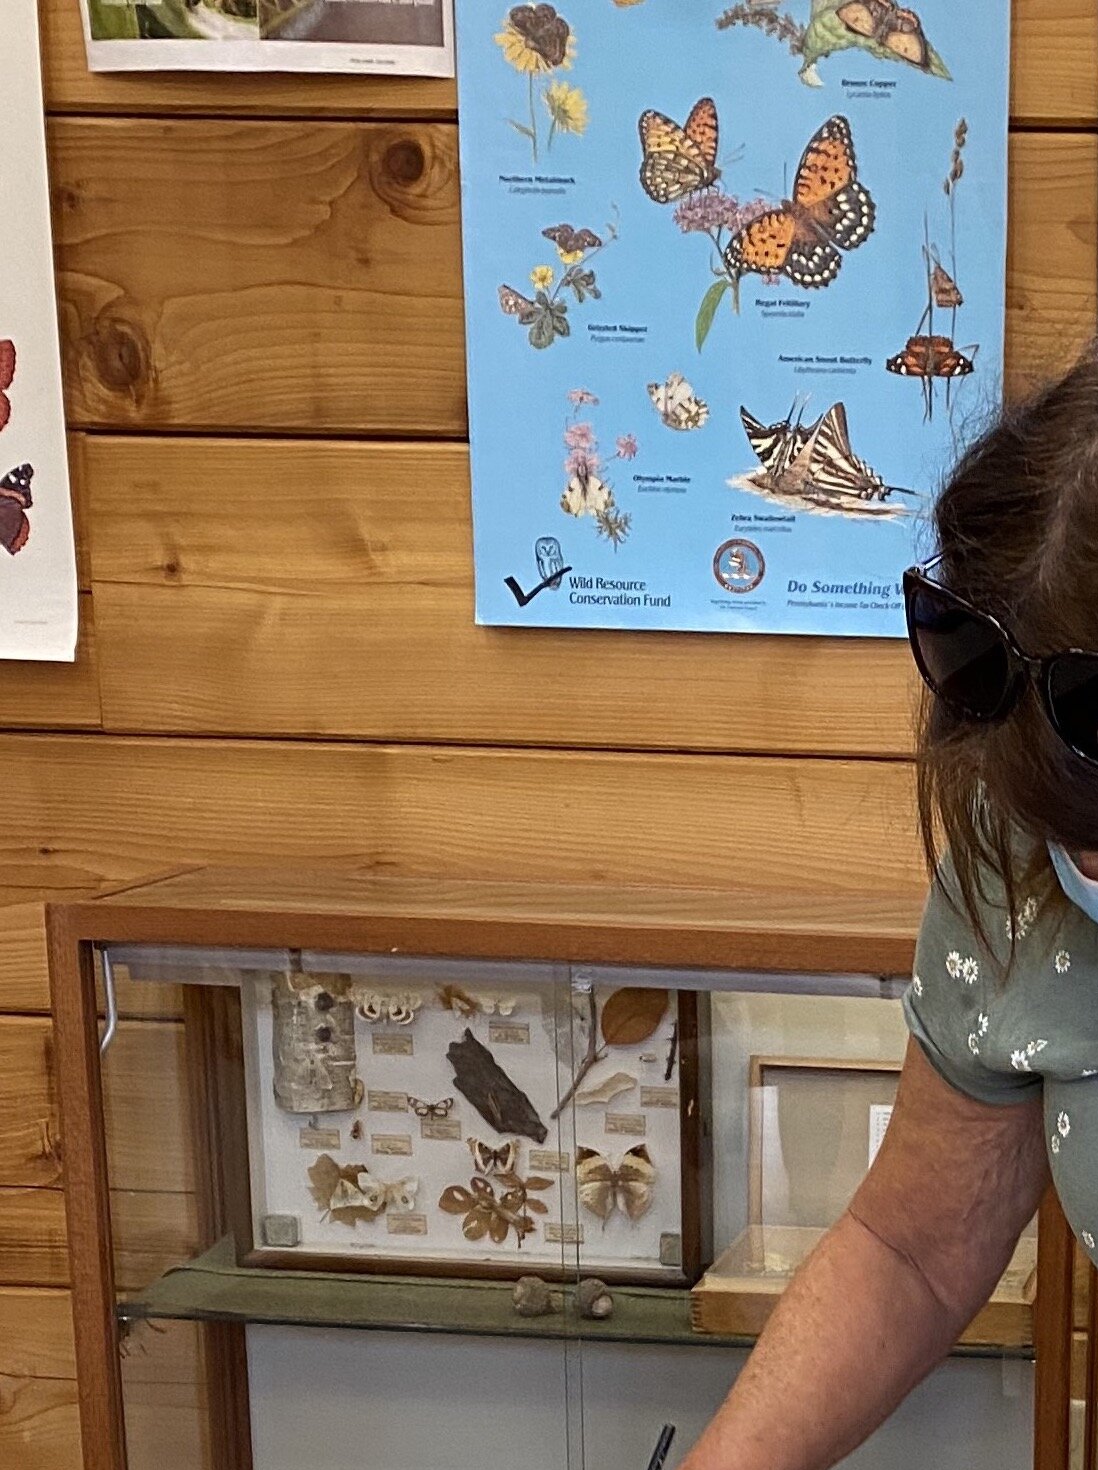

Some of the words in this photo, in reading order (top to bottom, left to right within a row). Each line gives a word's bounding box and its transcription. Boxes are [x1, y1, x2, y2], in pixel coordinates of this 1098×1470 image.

[569, 576, 593, 589] Wild
[595, 577, 647, 591] Resource
[787, 579, 808, 593] Do
[810, 580, 892, 599] Something
[569, 591, 641, 606] Conservation
[643, 593, 671, 607] Fund
